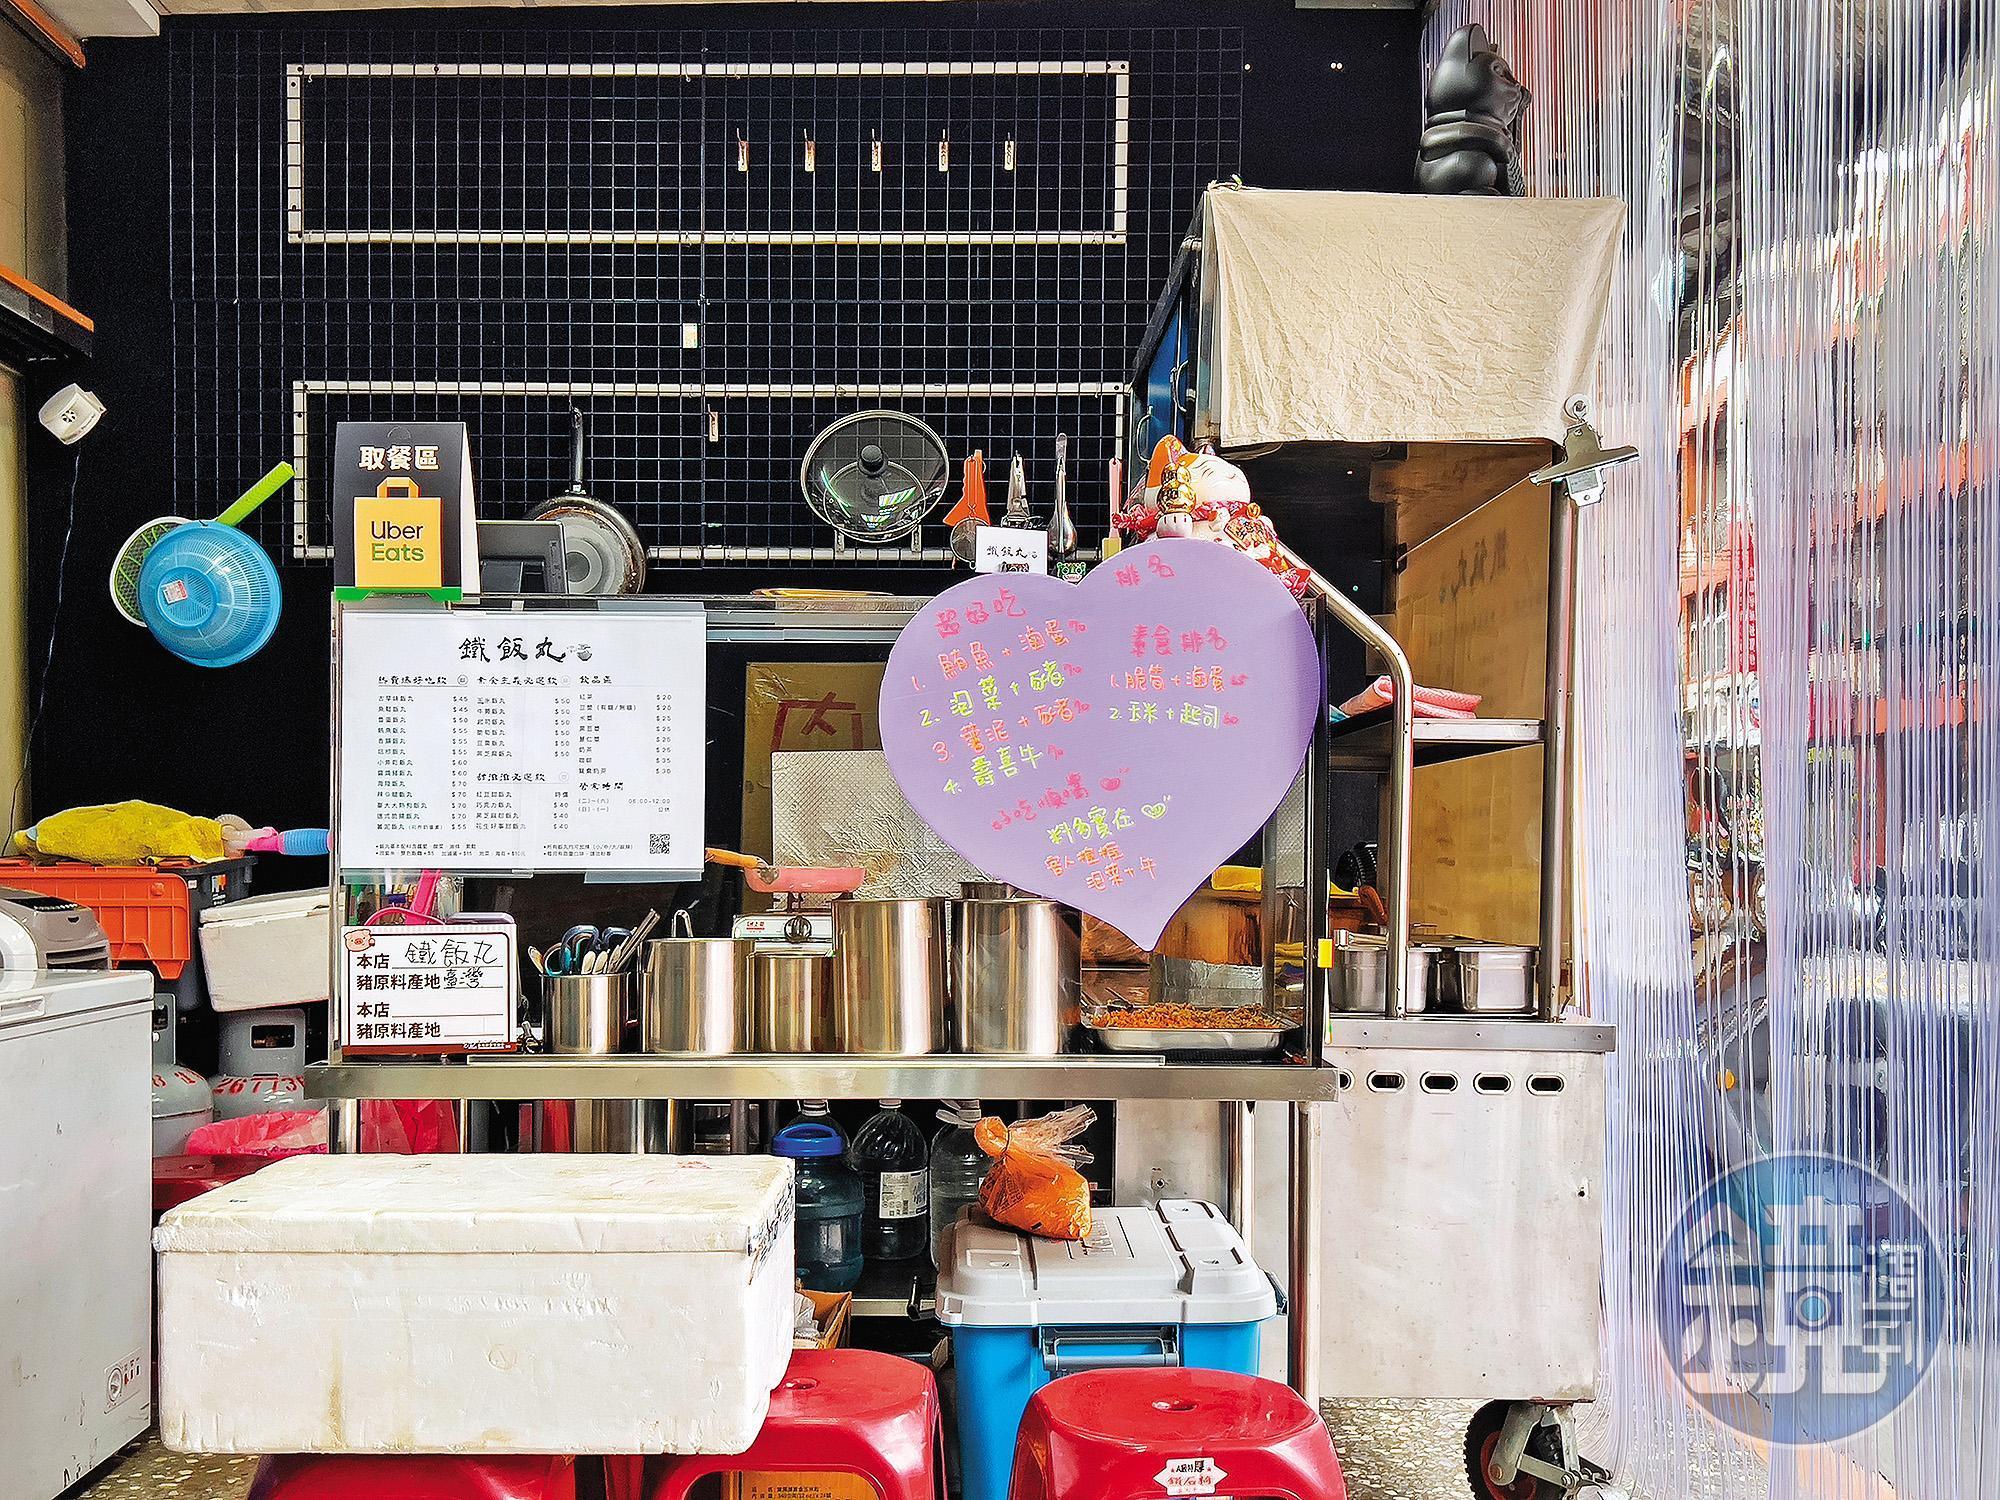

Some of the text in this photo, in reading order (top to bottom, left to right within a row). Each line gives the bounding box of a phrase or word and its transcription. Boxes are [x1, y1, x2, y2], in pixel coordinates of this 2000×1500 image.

[358, 444, 440, 471] 取餐區
[371, 521, 423, 539] Uber
[372, 543, 424, 561] Eats
[458, 636, 567, 663] 鐵飯丸
[578, 673, 613, 685] 飲品區
[554, 697, 571, 705] $50
[656, 692, 673, 703] $20
[554, 708, 571, 716] $50
[919, 708, 941, 727] 2.
[1109, 708, 1122, 720] 2.
[553, 718, 571, 728] $50
[554, 729, 571, 737] $50
[554, 750, 570, 758] $50
[932, 741, 953, 762] 3.
[971, 743, 1043, 788] 壽喜牛
[474, 799, 569, 811] 巧克力飯丸 $40
[553, 812, 569, 820] $40
[553, 823, 569, 832] $40
[1047, 806, 1135, 844] 料多實在
[356, 939, 497, 969] 本店 鐵飯丸
[356, 967, 484, 990] 豬原料產地 臺灣
[356, 1002, 389, 1018] 本店
[356, 1023, 440, 1039] 豬原料產地
